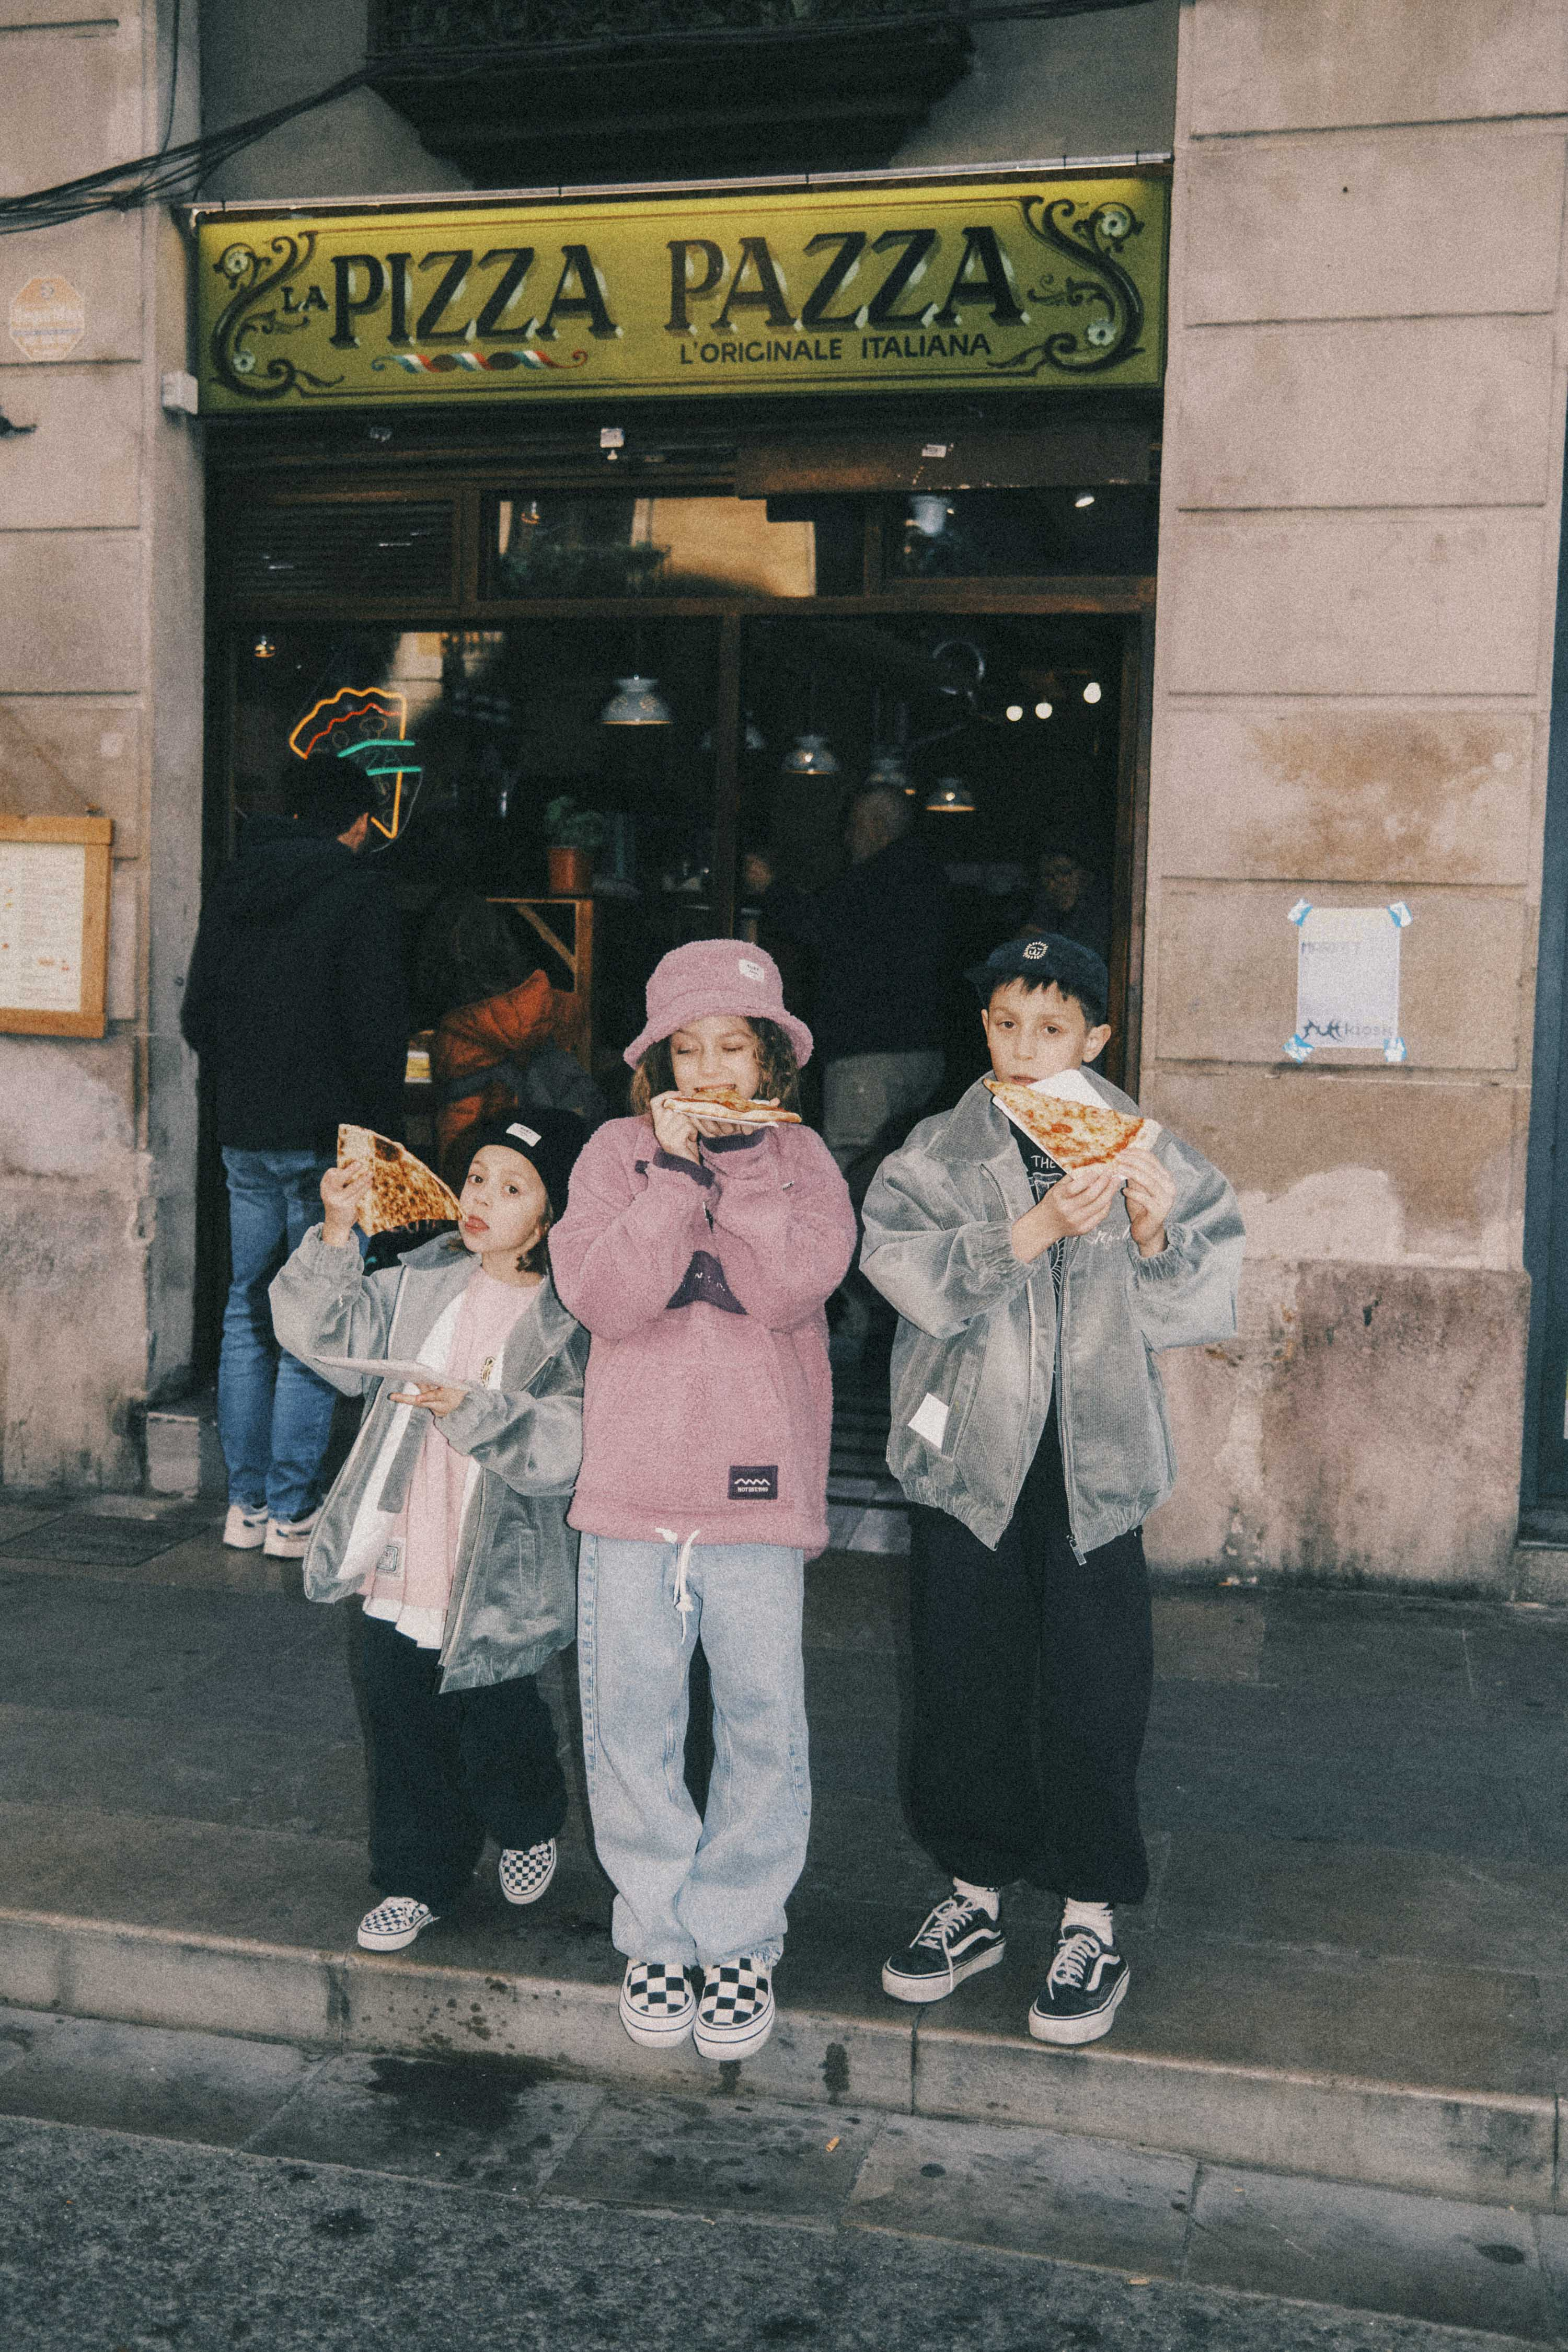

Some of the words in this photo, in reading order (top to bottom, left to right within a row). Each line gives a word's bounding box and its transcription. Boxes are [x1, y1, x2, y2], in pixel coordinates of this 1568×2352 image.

[281, 286, 328, 313] LA
[330, 244, 621, 349] PIZZA
[664, 226, 1030, 332] PAZZA
[681, 338, 843, 365] L'ORIGINALE
[861, 333, 991, 360] ITALIANA
